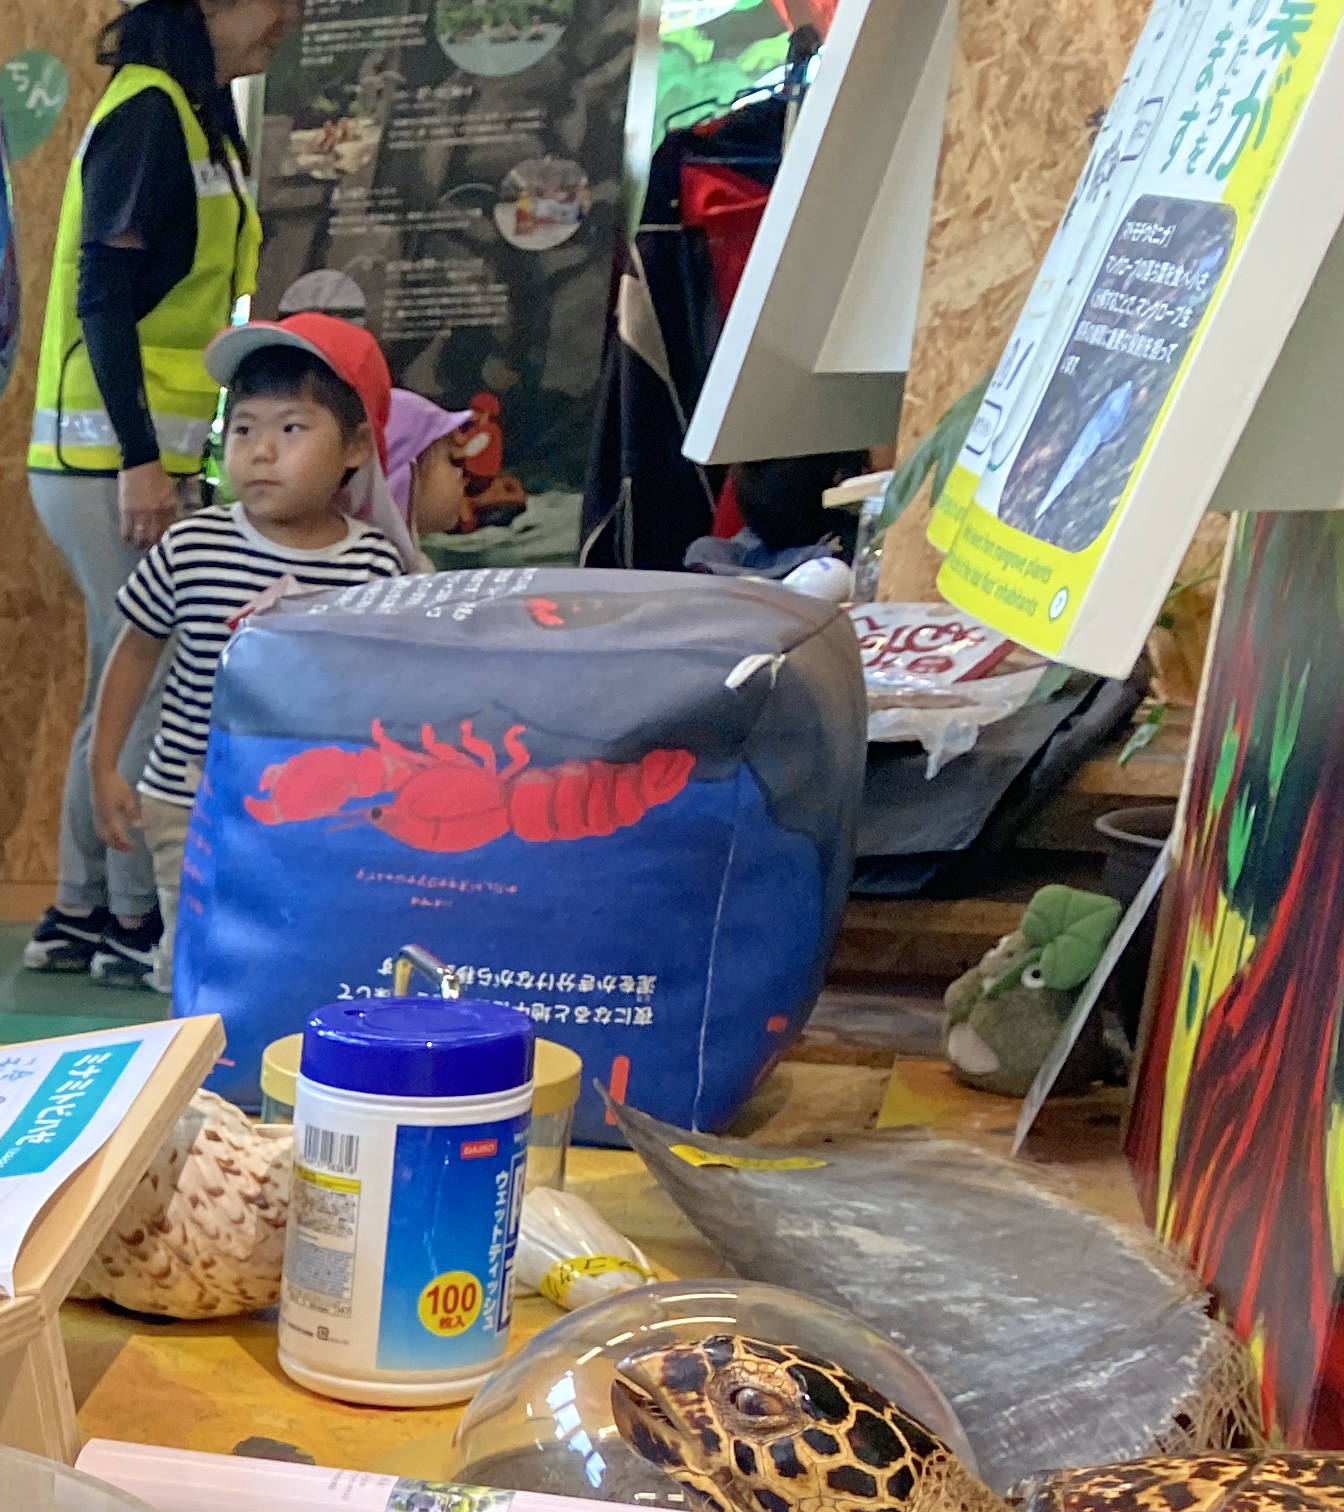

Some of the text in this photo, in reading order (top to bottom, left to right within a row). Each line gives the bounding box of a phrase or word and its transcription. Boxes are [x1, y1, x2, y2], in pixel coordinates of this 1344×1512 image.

[15, 1052, 112, 1146] ミナミトビハゼ
[426, 1282, 478, 1316] 100
[438, 1315, 465, 1330] 枚入
